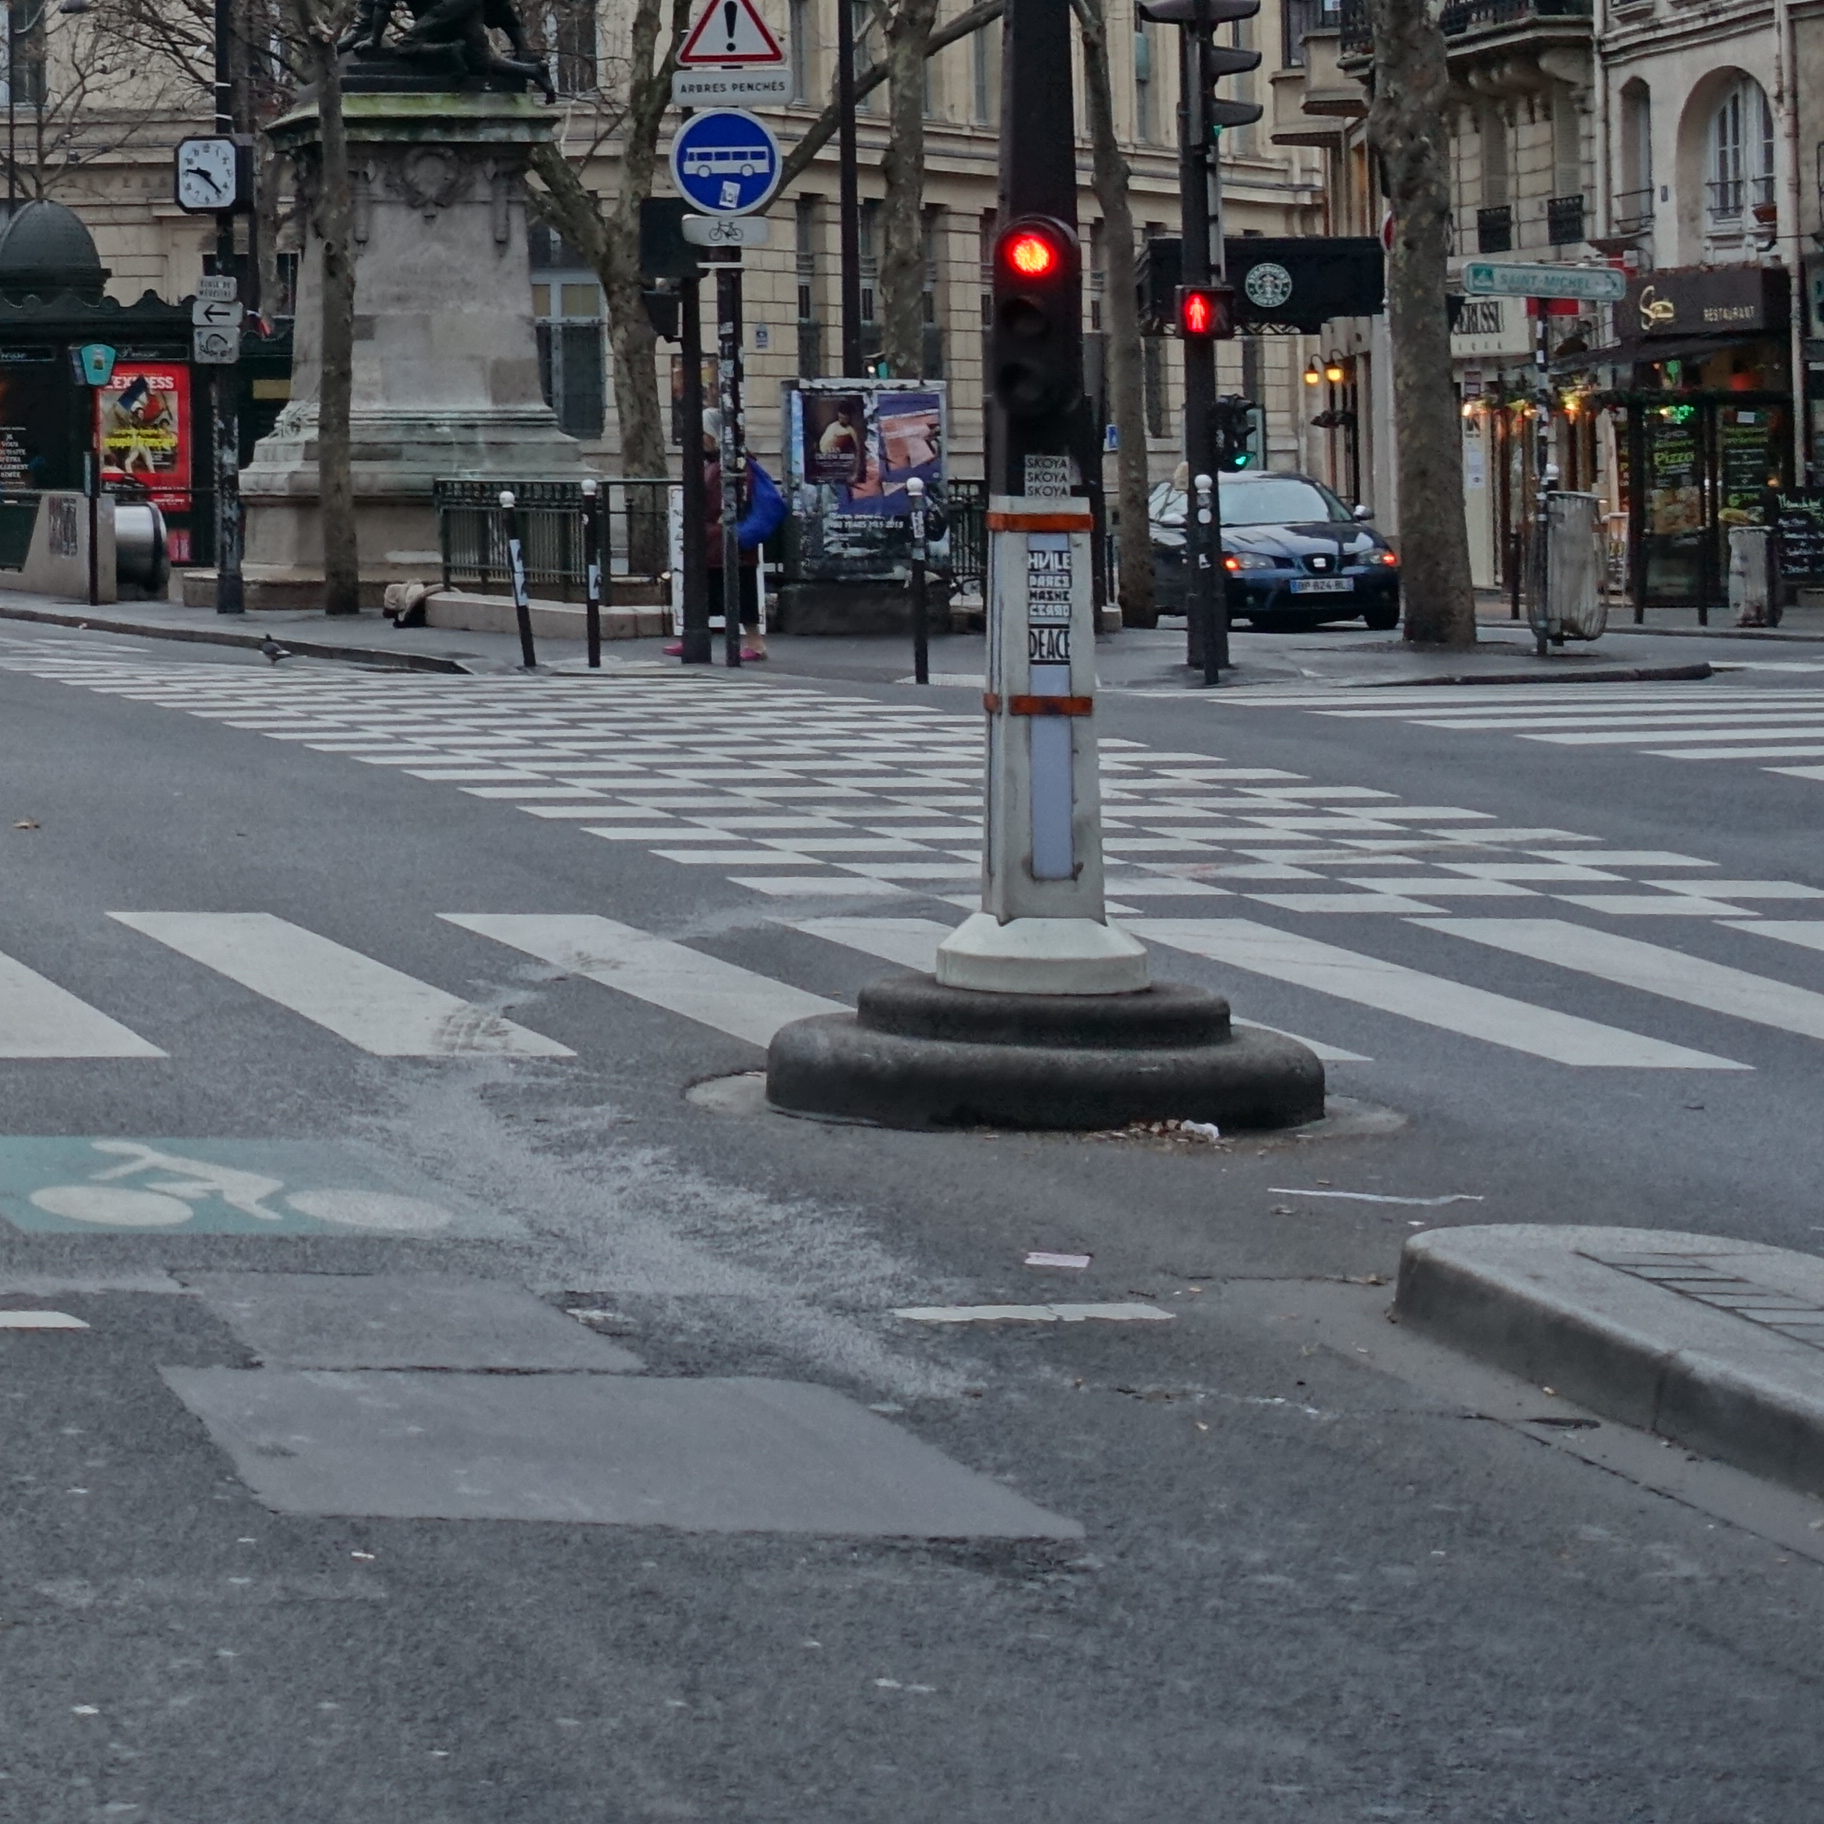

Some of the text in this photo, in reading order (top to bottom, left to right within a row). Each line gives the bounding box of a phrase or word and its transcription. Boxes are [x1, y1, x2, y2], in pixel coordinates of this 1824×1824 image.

[680, 80, 786, 93] ARBRES PENCHÉS
[1027, 458, 1068, 469] SKOYA
[1027, 472, 1068, 483] SKOYA
[1027, 485, 1068, 497] SKOYA
